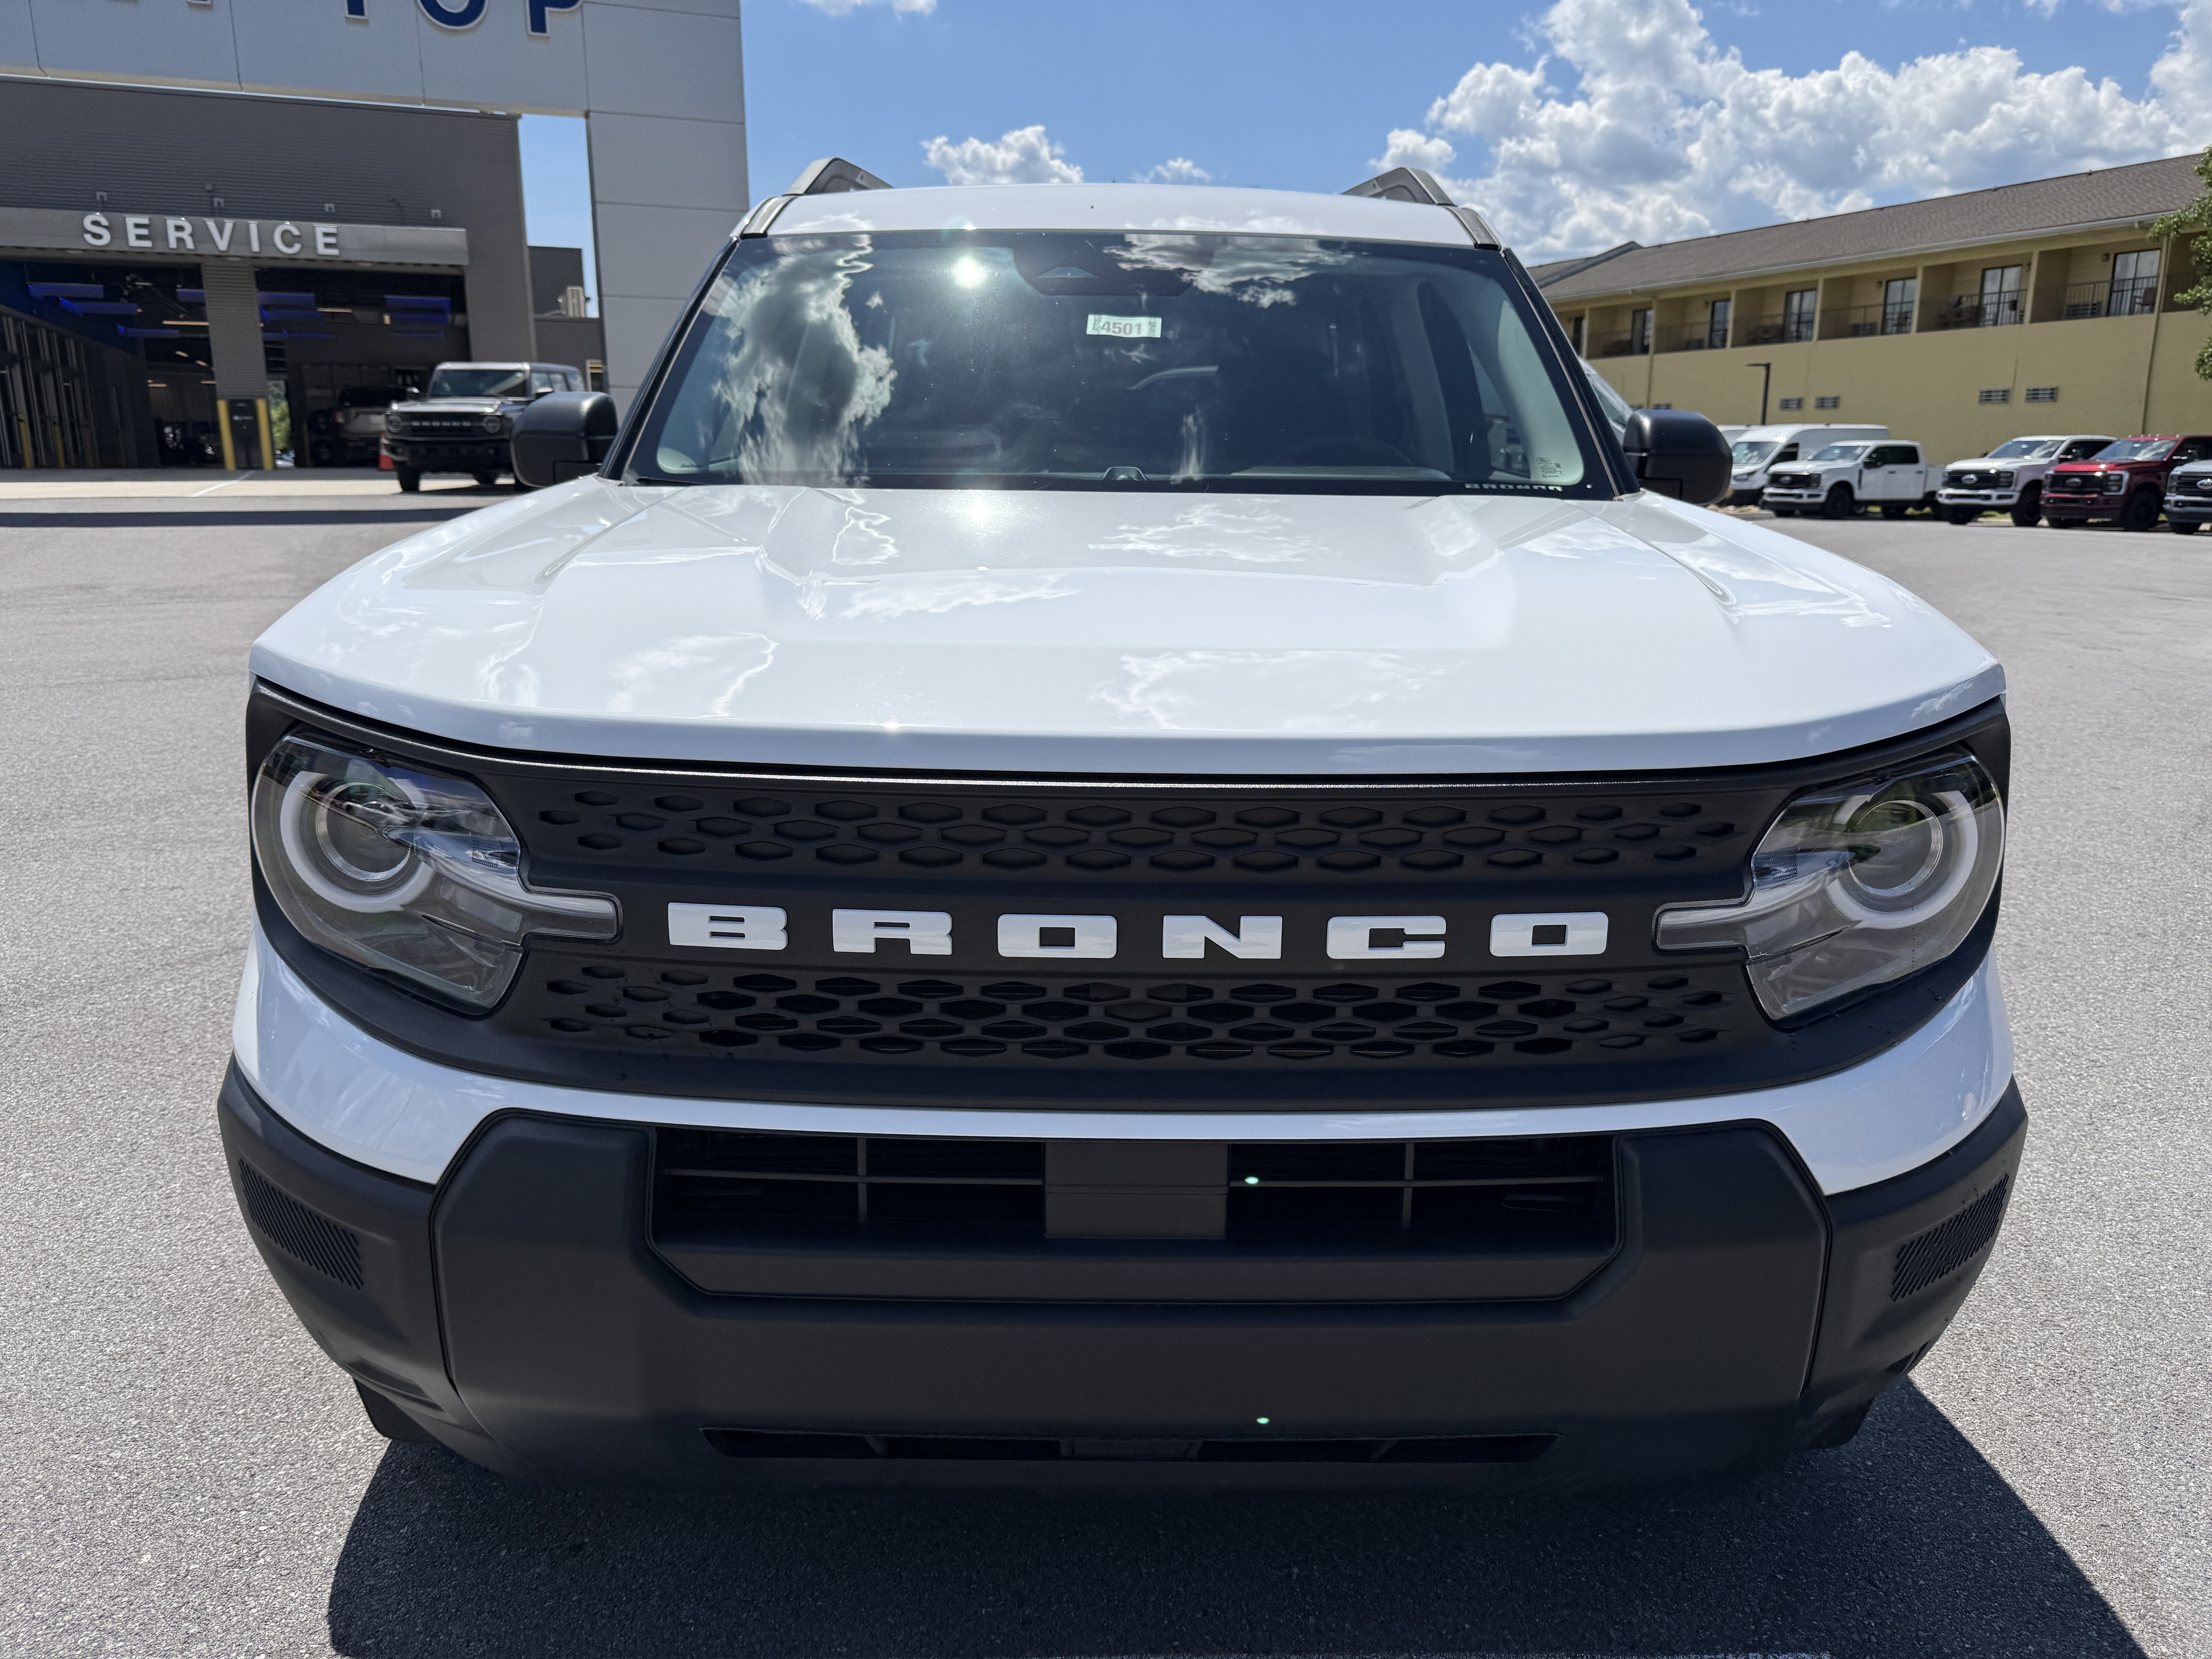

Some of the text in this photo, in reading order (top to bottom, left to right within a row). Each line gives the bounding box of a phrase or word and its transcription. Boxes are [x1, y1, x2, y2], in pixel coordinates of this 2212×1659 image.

[82, 213, 340, 256] SERVICE
[1101, 321, 1142, 335] 4501
[668, 902, 1608, 959] BRONCO
